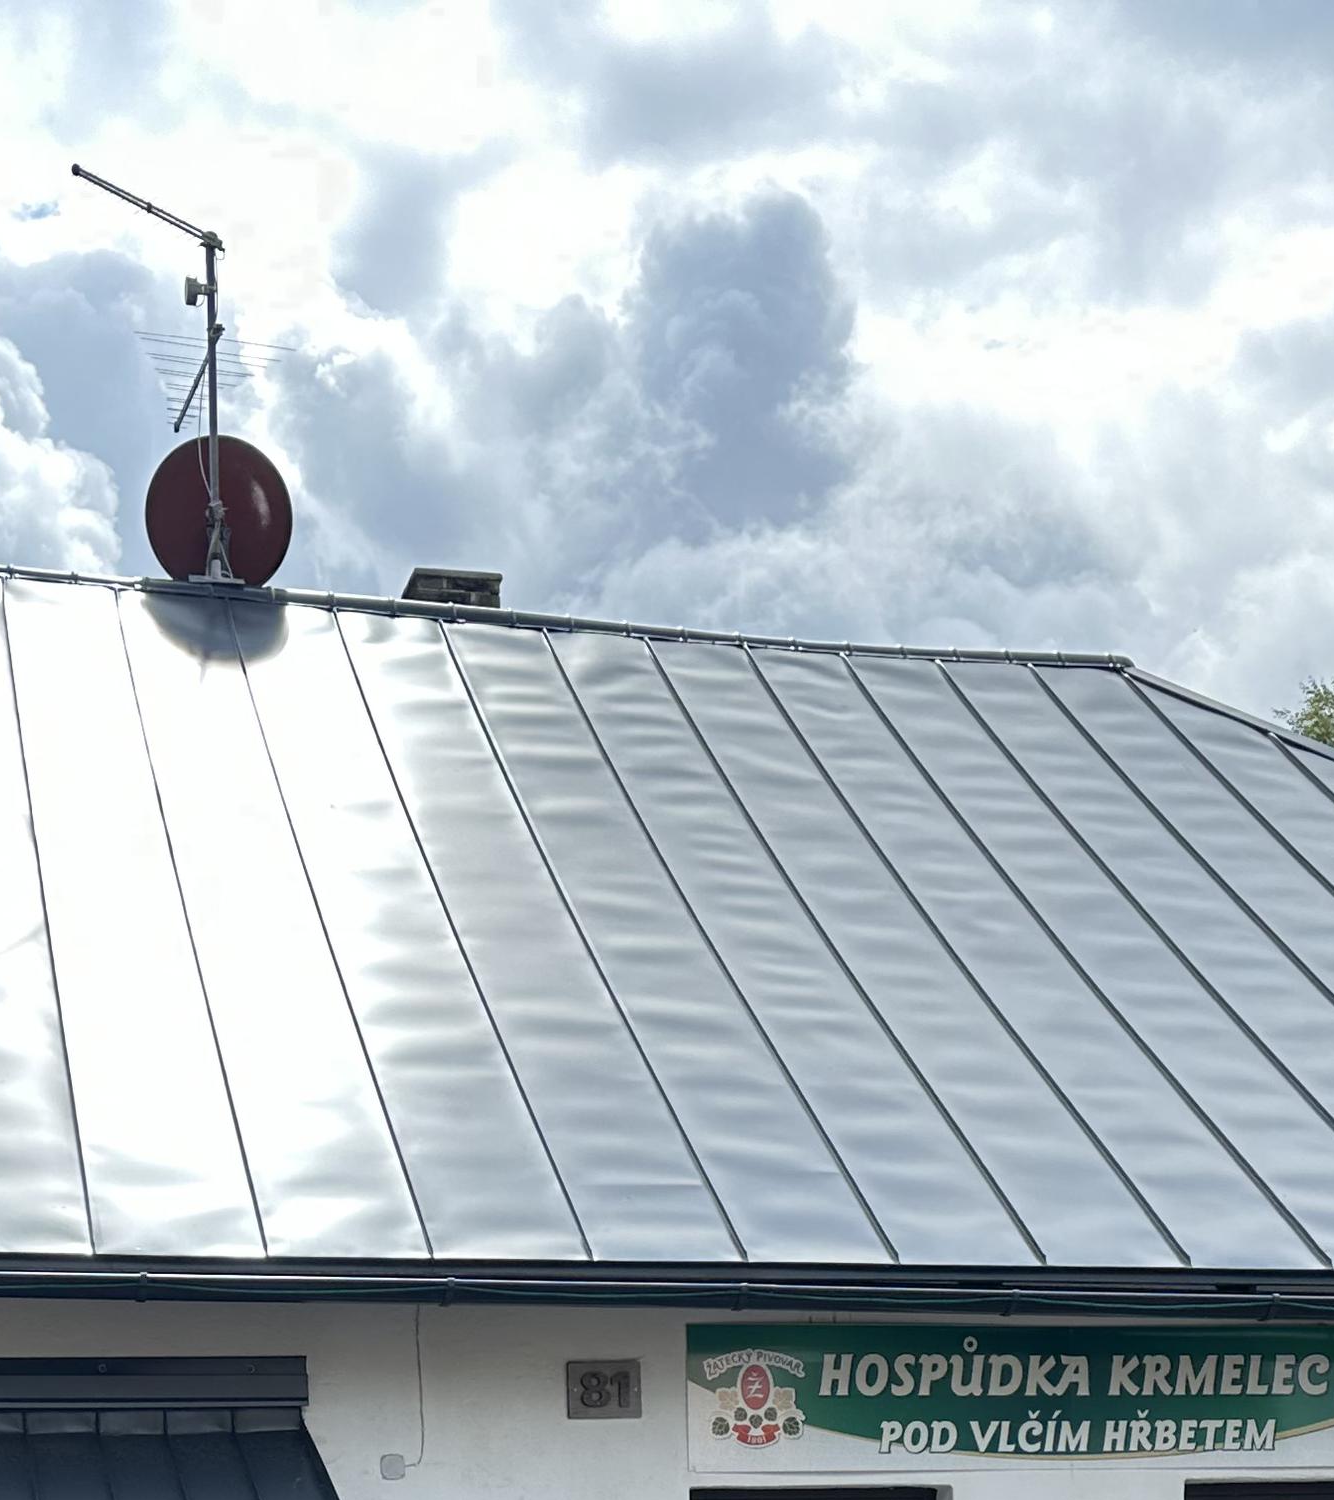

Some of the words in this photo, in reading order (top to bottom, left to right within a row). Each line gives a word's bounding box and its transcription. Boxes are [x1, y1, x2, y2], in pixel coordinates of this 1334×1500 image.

[705, 1352, 753, 1377] ŽATECKÝ
[756, 1352, 804, 1375] PIVOVAR
[819, 1336, 1090, 1396] HOSPŮDKA
[1108, 1354, 1330, 1396] KRMELEC
[580, 1371, 631, 1408] 81
[879, 1420, 958, 1453] POD
[969, 1409, 1091, 1453] VLČÍM
[1102, 1409, 1276, 1451] HŘBETEM
